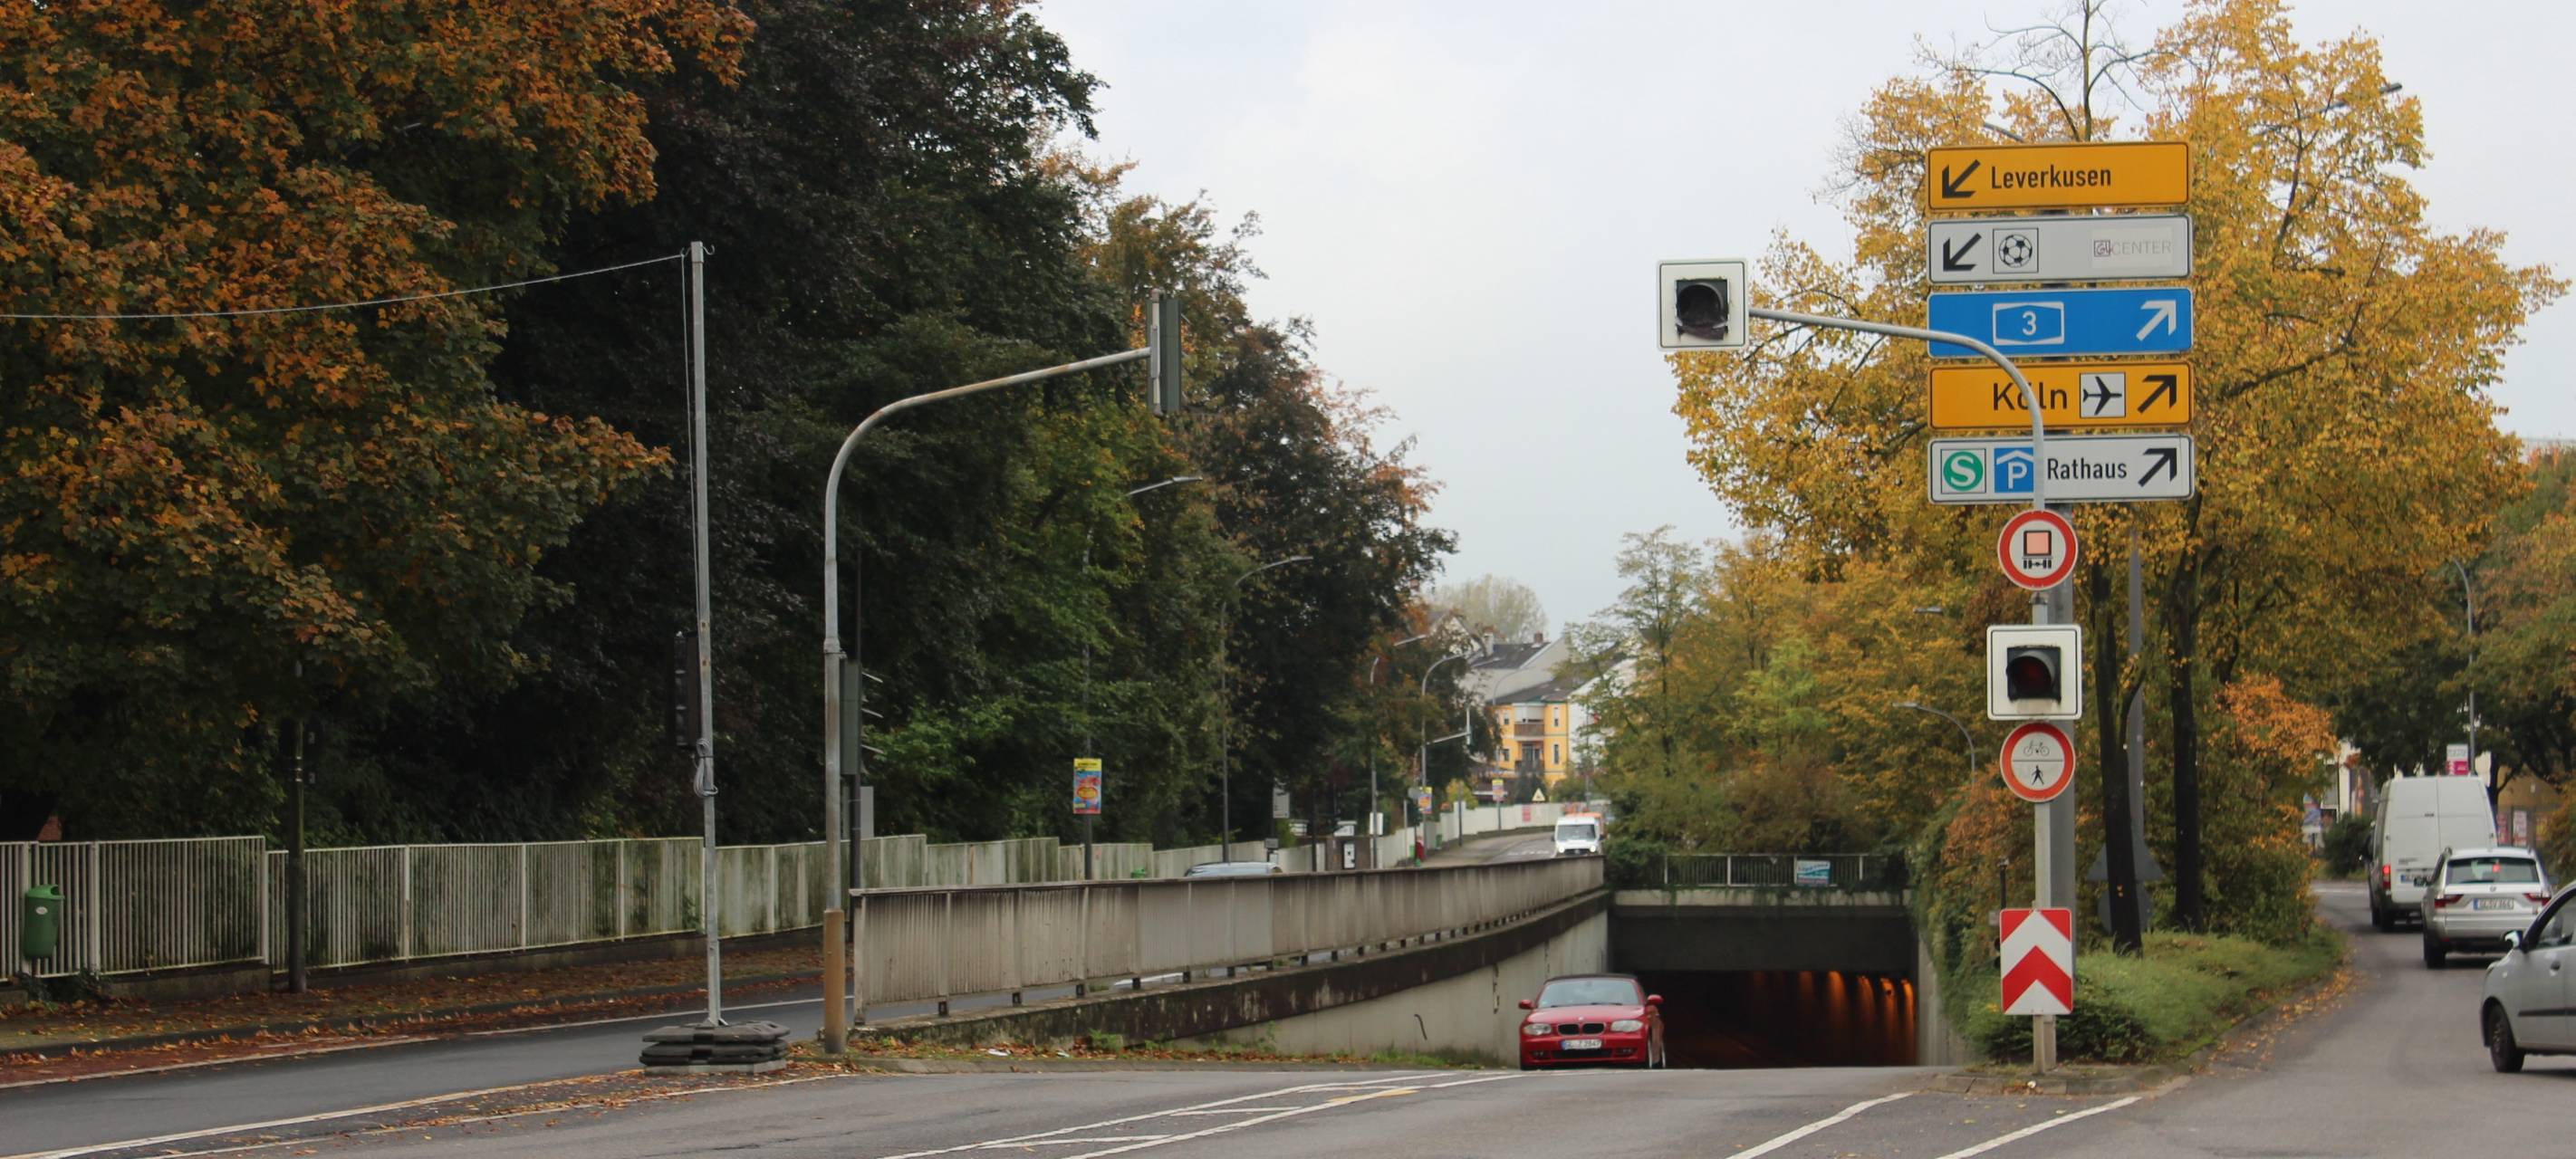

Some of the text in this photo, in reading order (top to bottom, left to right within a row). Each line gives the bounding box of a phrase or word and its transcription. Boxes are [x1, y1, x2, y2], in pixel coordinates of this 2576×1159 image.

[1991, 164, 2111, 189] Leverkusen
[2112, 239, 2172, 256] CENTER
[2022, 311, 2037, 336] 3
[1950, 455, 2127, 489] S P Rathaus
